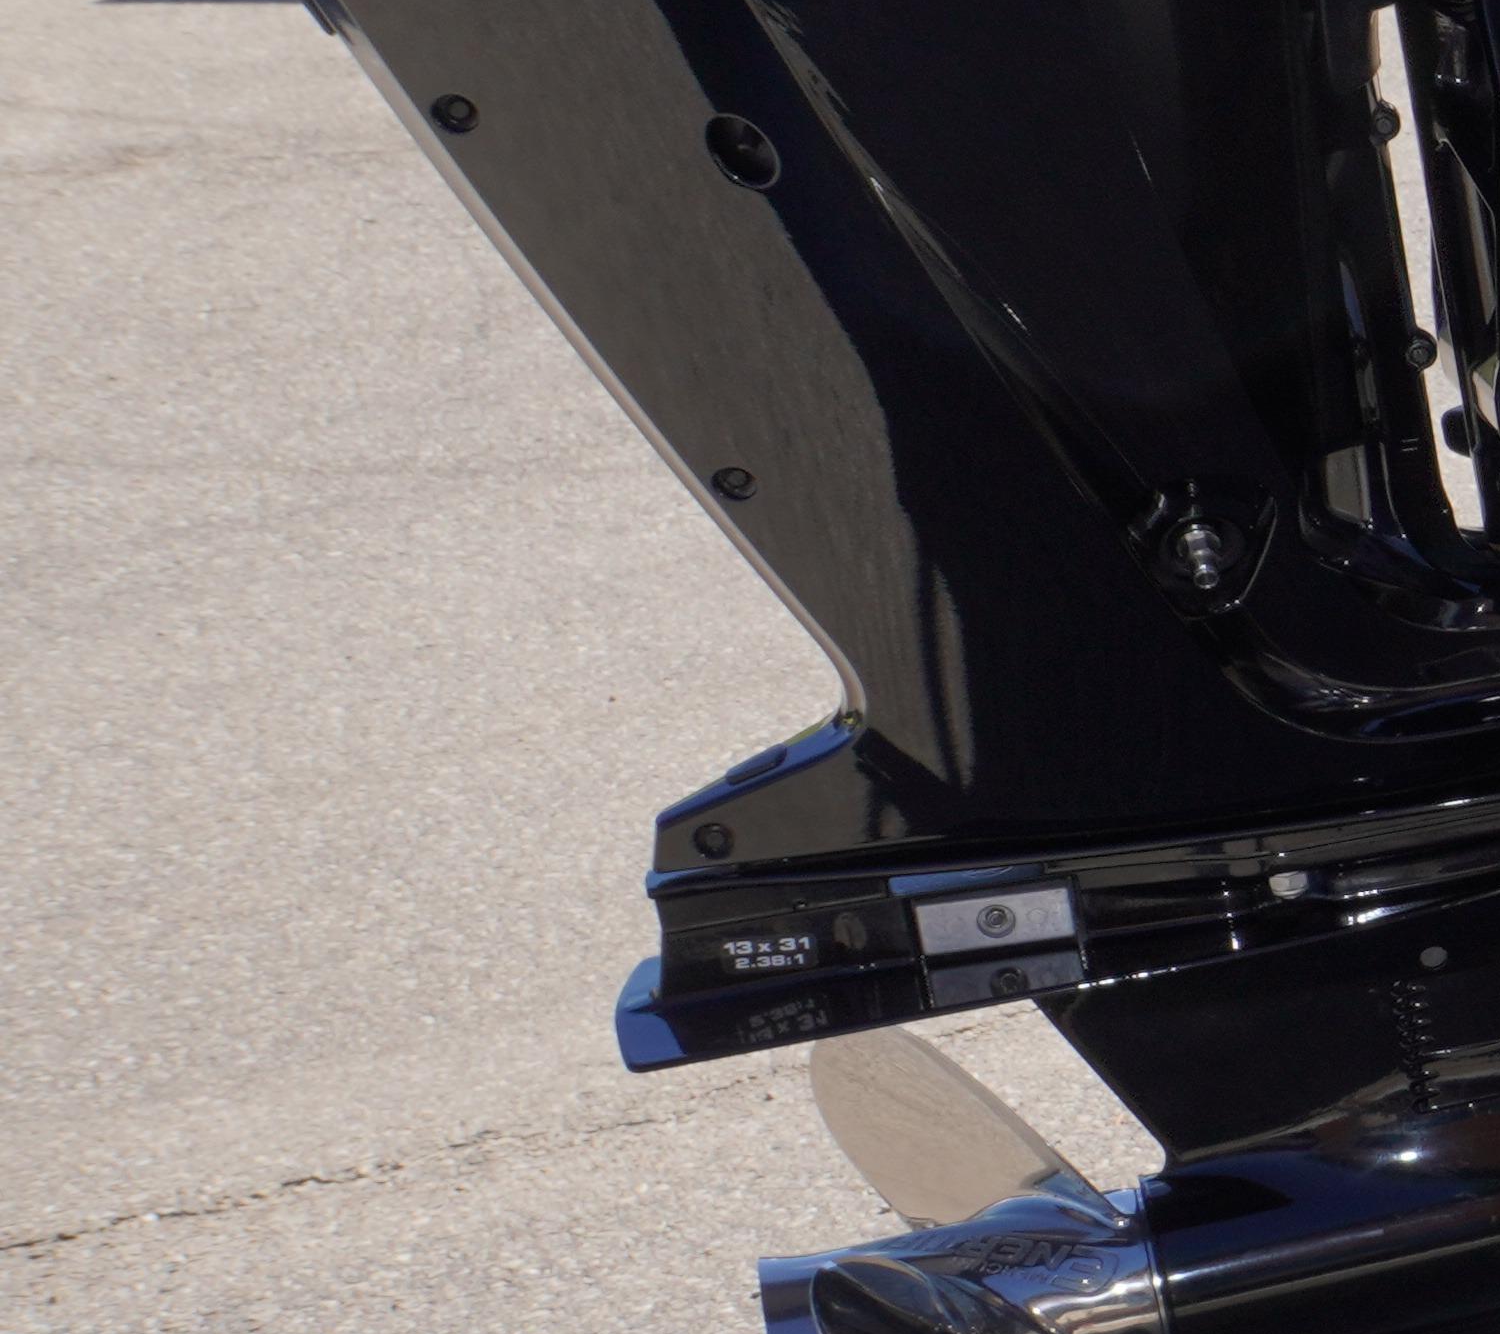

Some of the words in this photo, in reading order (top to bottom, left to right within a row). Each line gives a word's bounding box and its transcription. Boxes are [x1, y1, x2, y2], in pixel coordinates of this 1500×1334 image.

[723, 941, 752, 955] 13
[758, 943, 772, 953] x
[779, 937, 810, 951] 31
[735, 954, 804, 969] 2.38:1
